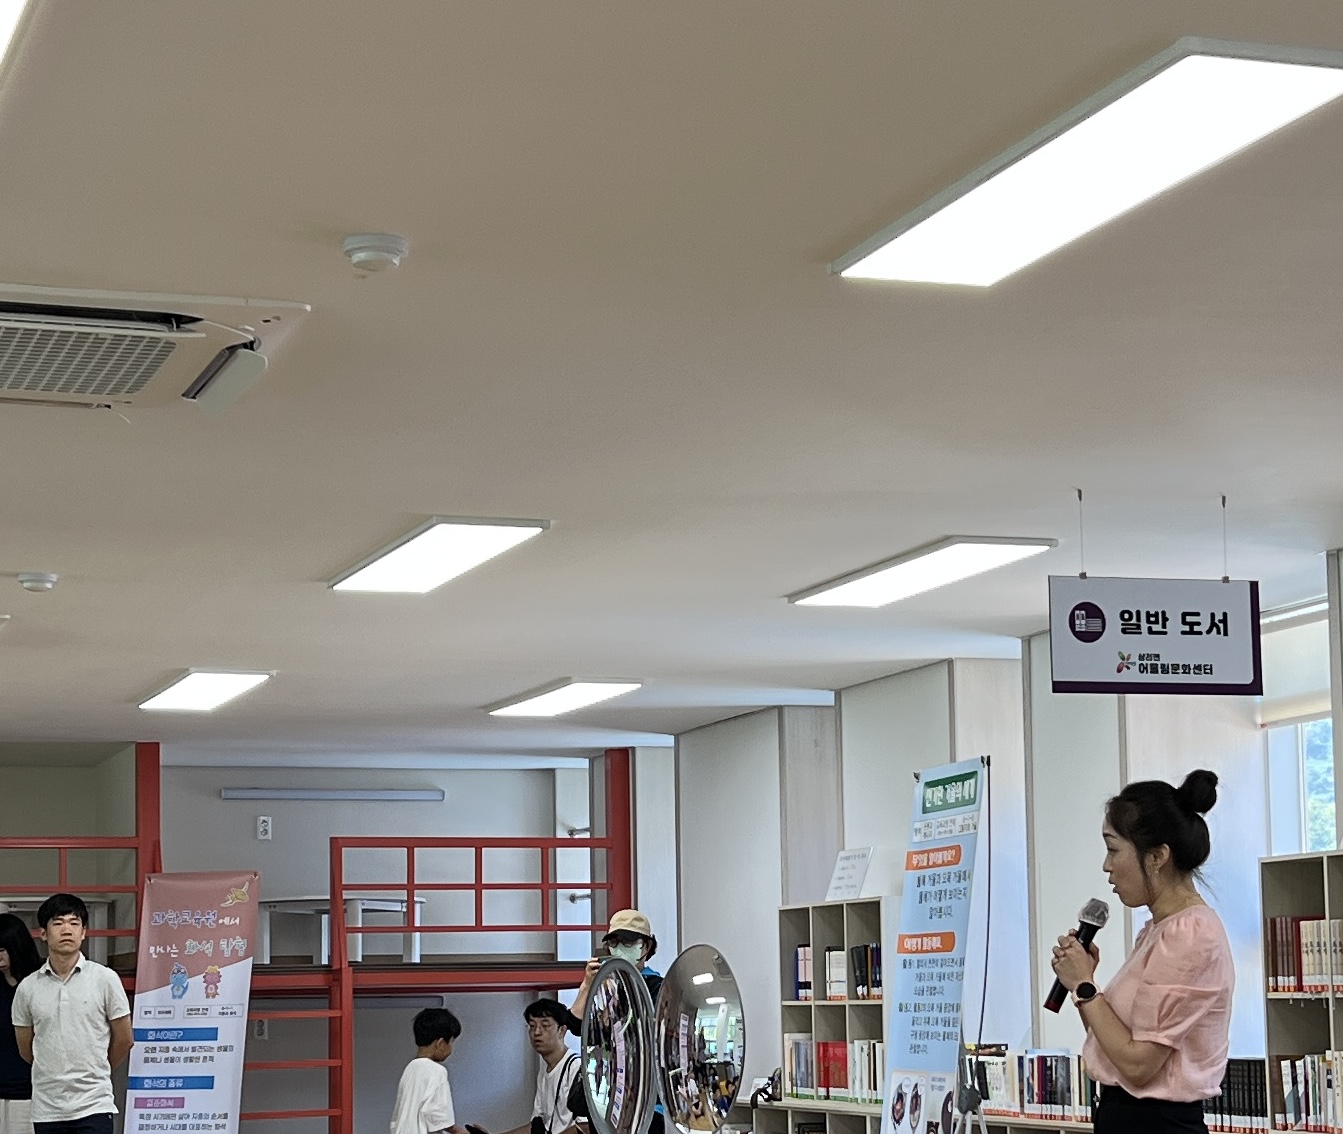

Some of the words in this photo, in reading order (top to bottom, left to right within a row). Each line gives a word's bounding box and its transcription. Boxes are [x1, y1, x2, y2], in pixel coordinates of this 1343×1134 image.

[1119, 609, 1169, 635] 일반
[1180, 611, 1229, 637] 도서
[1138, 663, 1213, 675] 어울림문화센터
